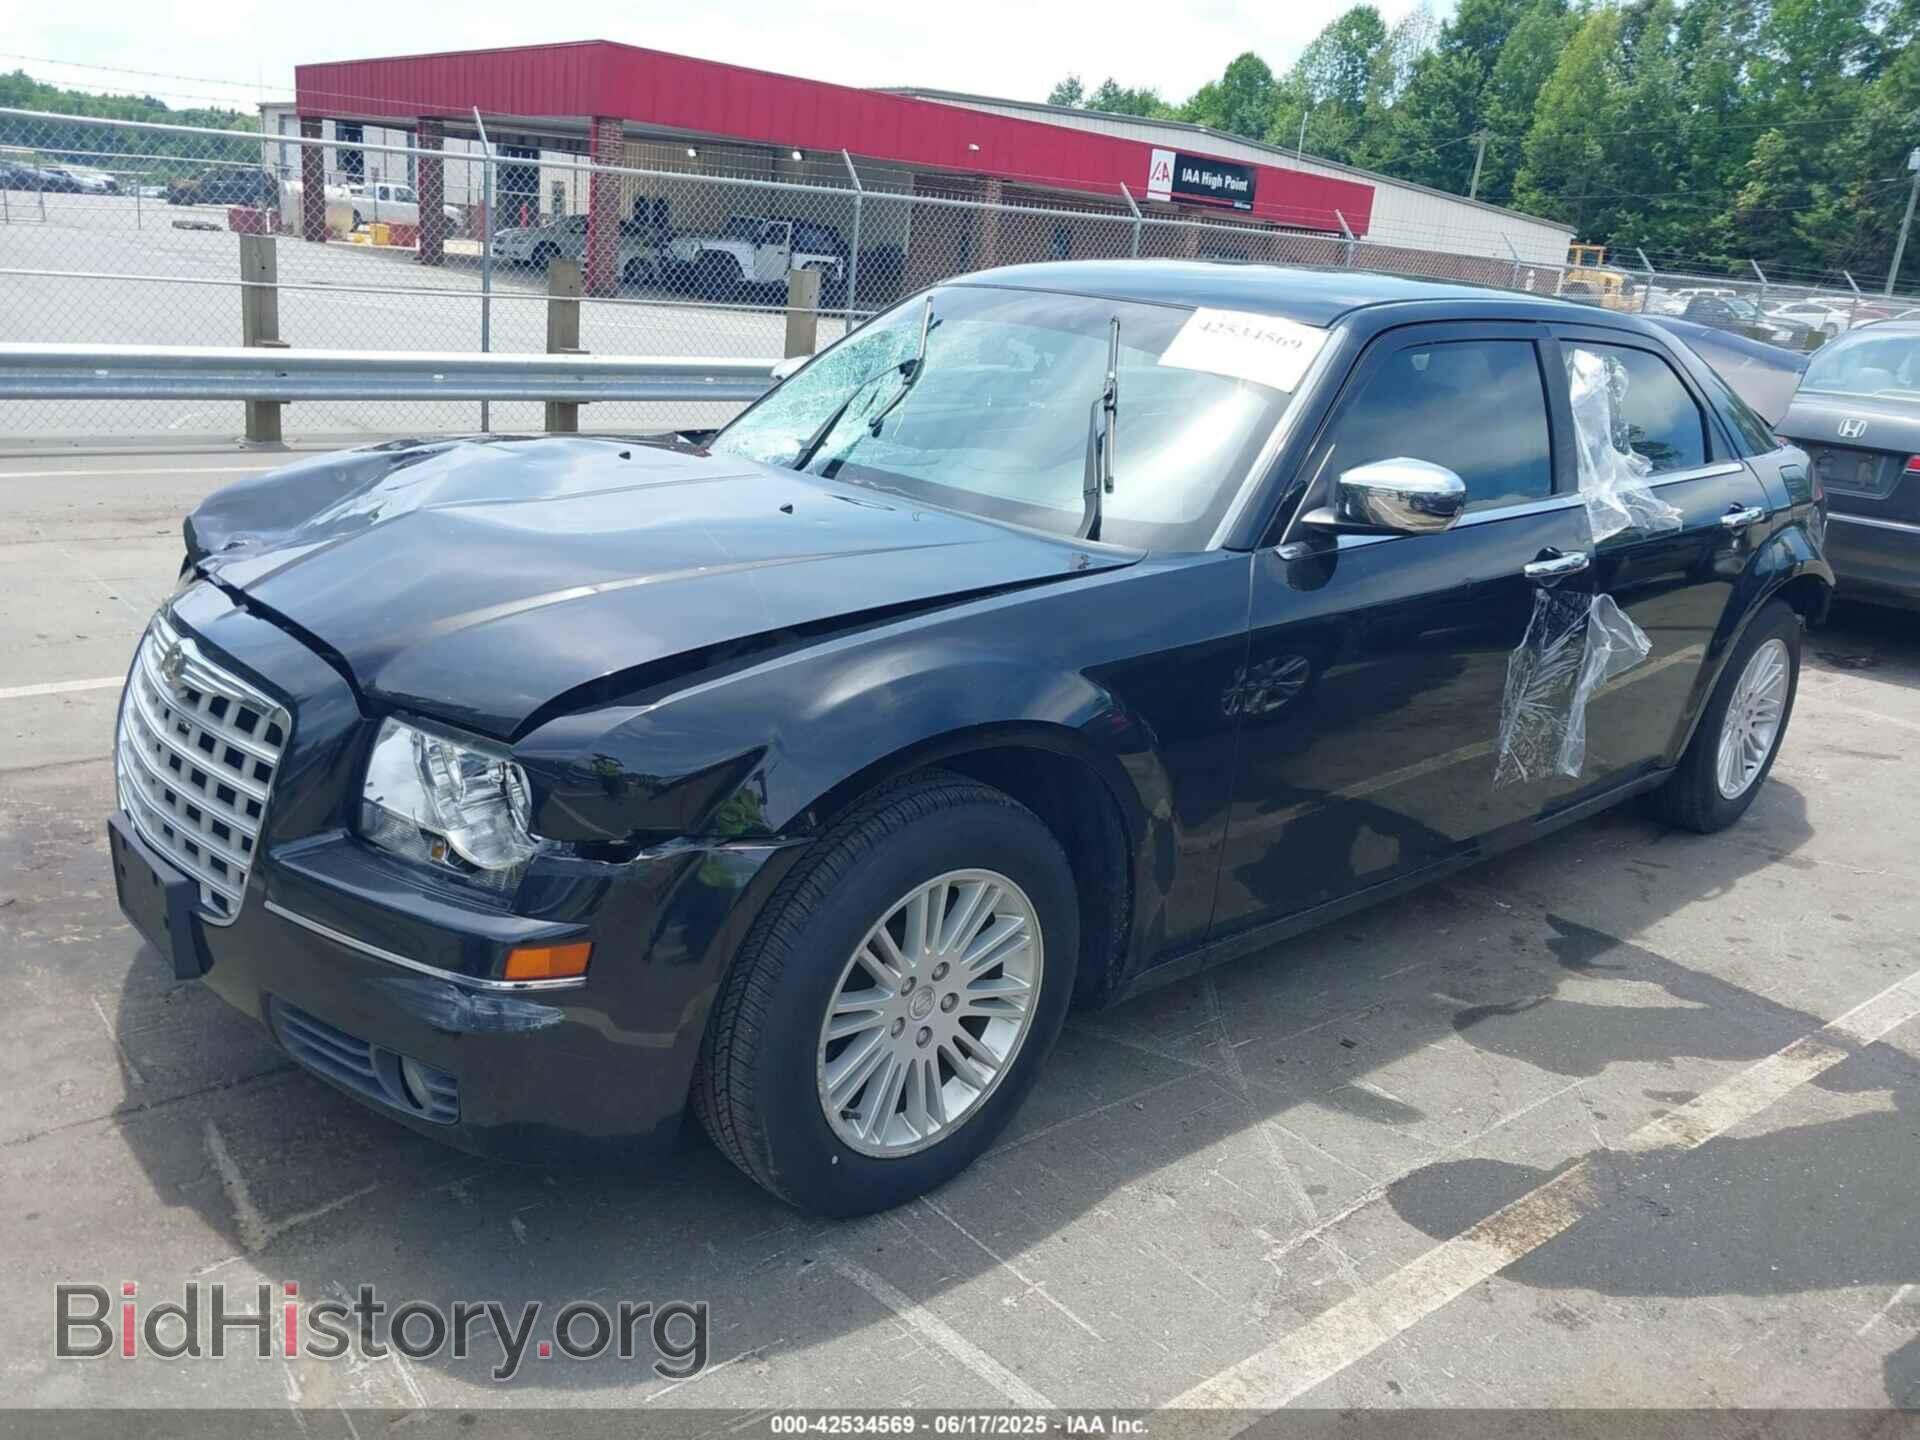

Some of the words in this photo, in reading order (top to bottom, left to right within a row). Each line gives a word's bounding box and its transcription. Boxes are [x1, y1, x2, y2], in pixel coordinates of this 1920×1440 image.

[1182, 168, 1200, 184] IAA
[1201, 172, 1223, 190] High
[1224, 175, 1248, 192] Point
